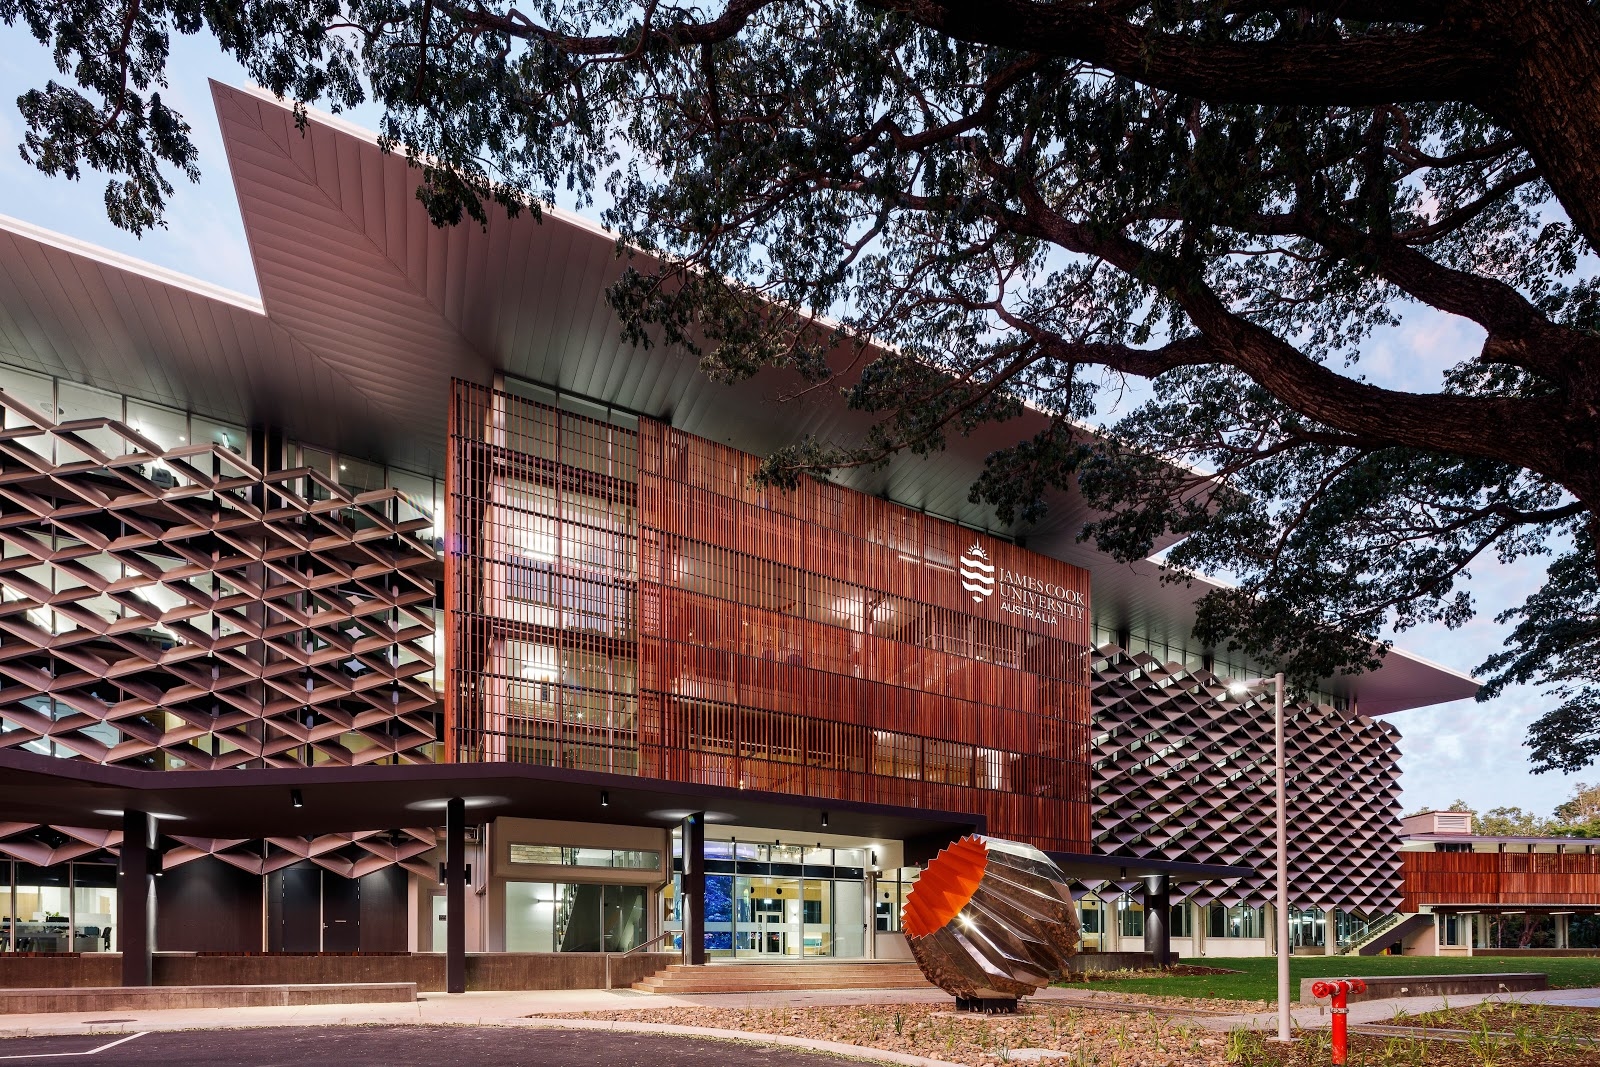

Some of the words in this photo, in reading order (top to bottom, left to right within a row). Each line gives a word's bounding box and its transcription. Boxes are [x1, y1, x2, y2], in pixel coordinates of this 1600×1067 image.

[1000, 567, 1044, 592] JAMES
[1045, 583, 1085, 606] COOK
[1000, 583, 1084, 619] UNIVERSITY
[1000, 602, 1058, 625] AUSTRALIA
